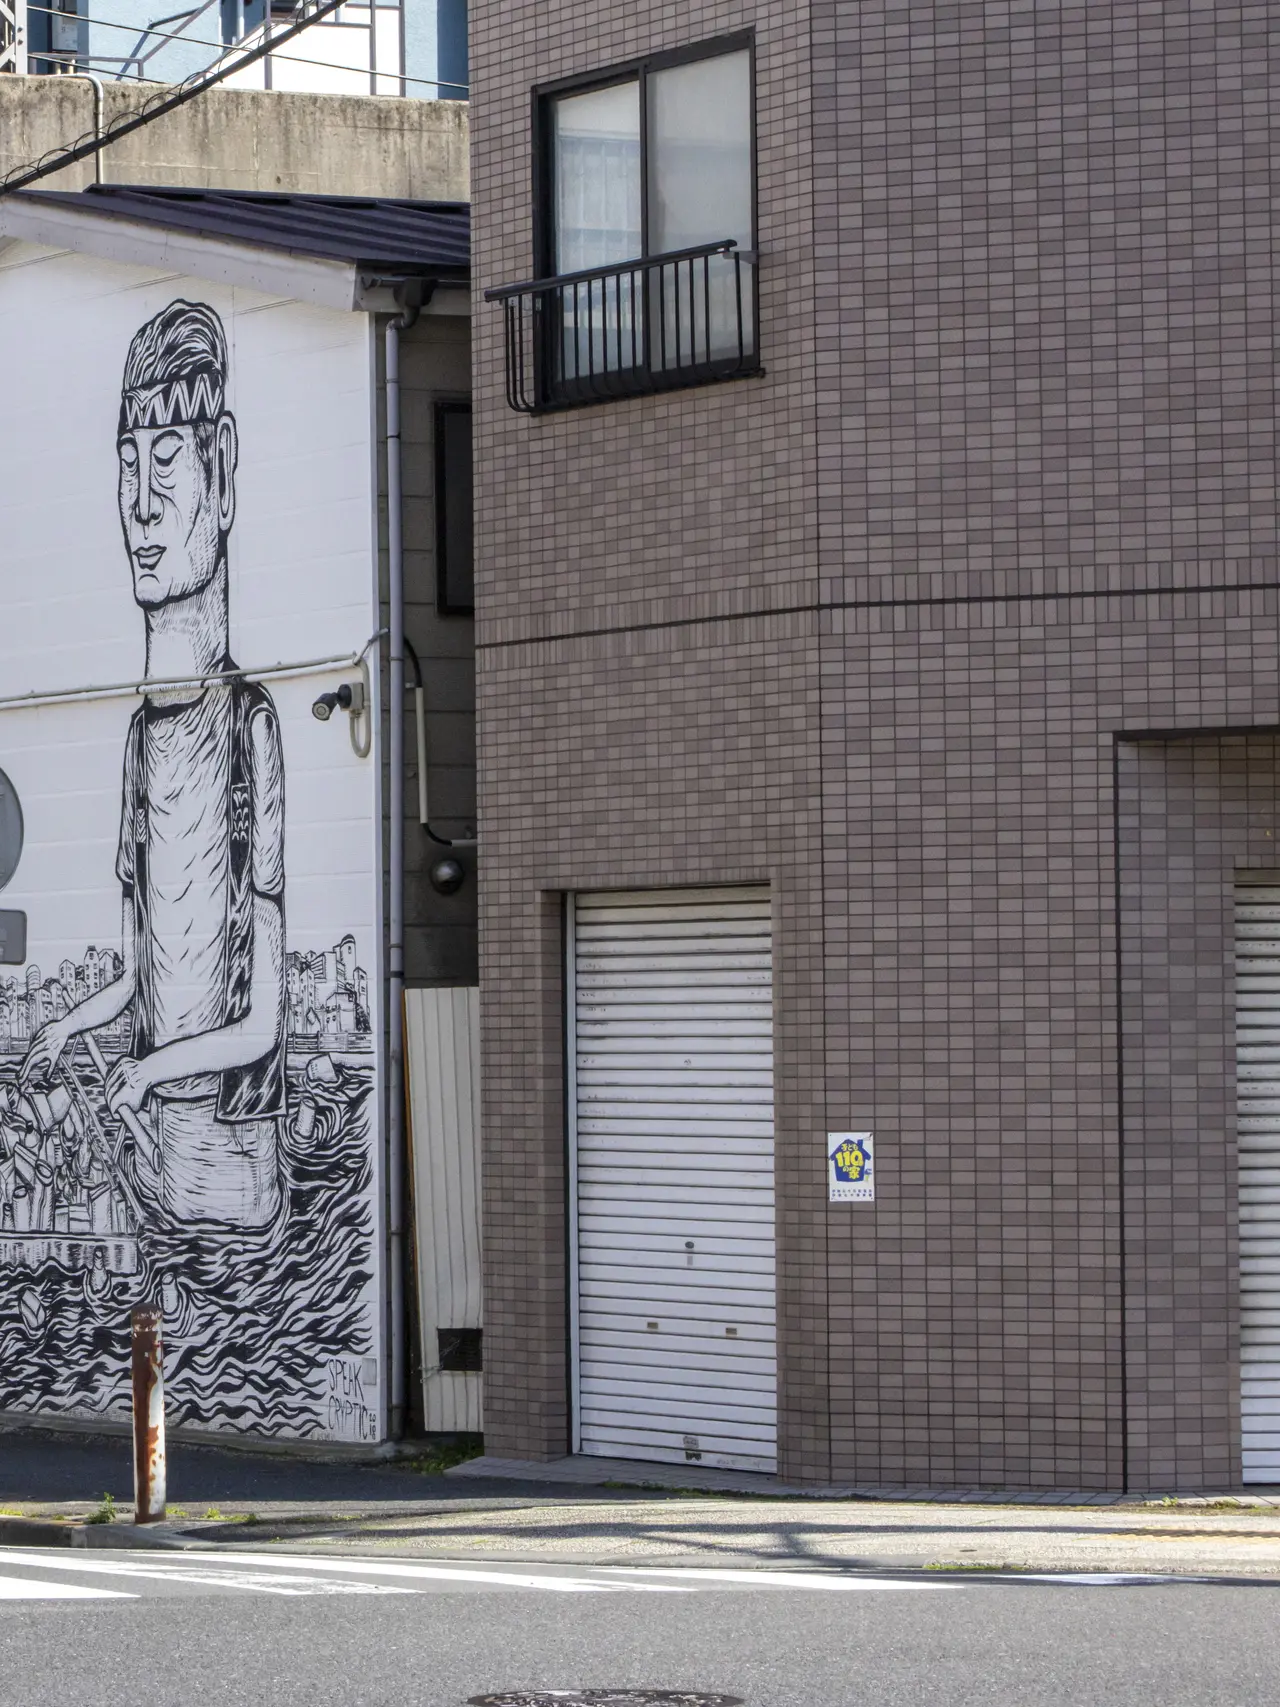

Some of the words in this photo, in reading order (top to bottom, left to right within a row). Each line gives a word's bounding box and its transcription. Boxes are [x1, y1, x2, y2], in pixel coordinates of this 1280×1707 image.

[841, 1143, 859, 1151] 子ども
[842, 1165, 861, 1180] の家
[327, 1358, 365, 1402] SPEAK
[327, 1394, 368, 1441] CRYPTIC
